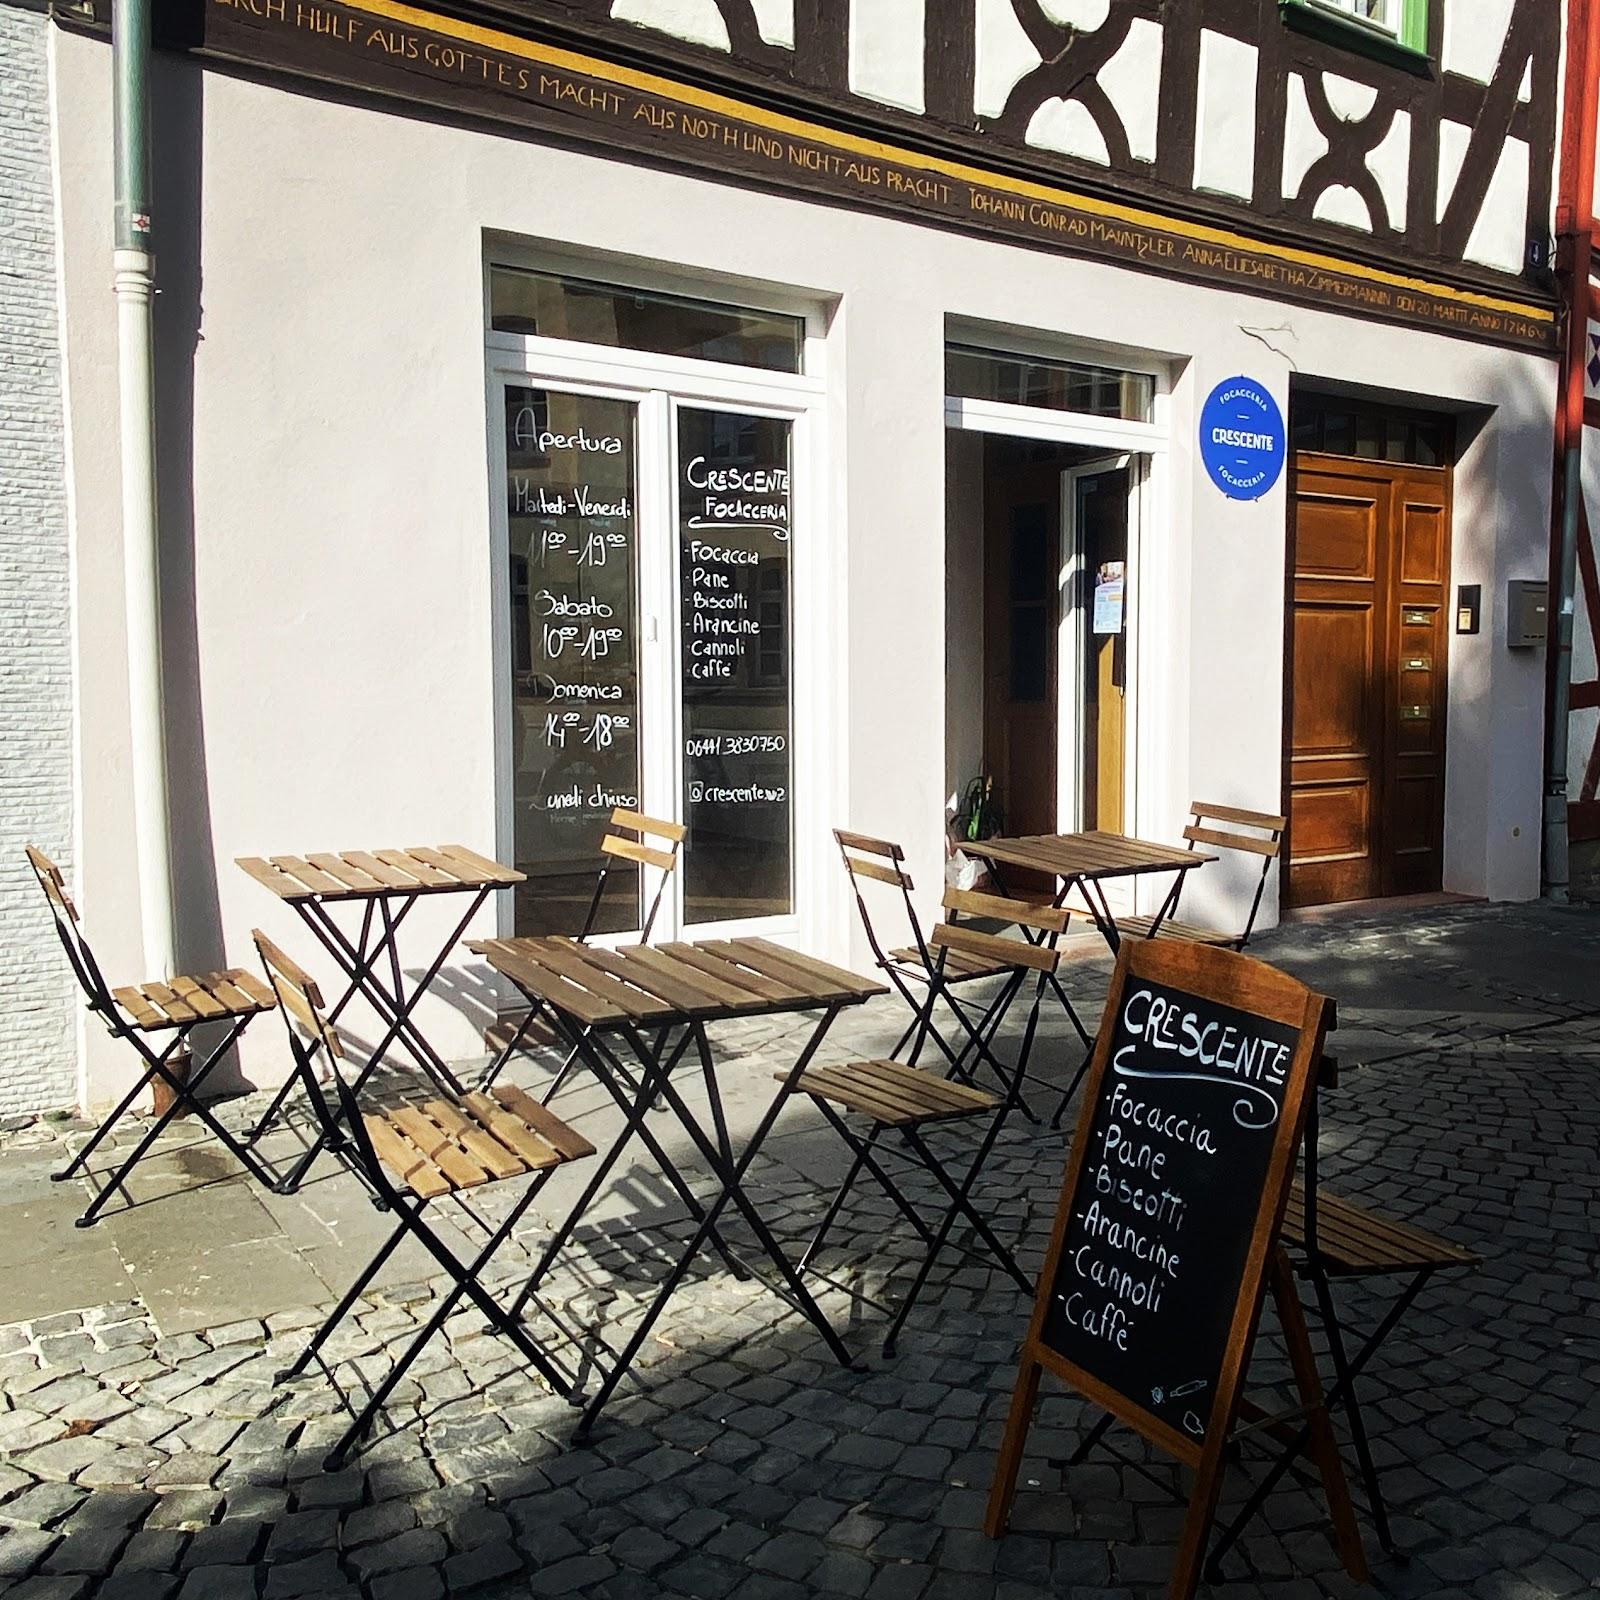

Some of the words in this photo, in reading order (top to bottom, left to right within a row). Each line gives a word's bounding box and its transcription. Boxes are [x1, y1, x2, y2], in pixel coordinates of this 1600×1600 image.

[540, 75, 625, 114] MACHT
[634, 104, 675, 129] AUS
[744, 130, 783, 159] UND
[788, 147, 844, 175] NICHT
[845, 162, 880, 184] AUS
[887, 170, 952, 204] PRACHT
[1219, 389, 1268, 412] FOCACCERIA
[515, 407, 622, 453] Apertura
[1212, 428, 1273, 451] CRESCENTE
[1217, 465, 1266, 488] FOCACCERIA
[535, 590, 614, 617] Sabato
[588, 783, 637, 808] chiuso
[1124, 990, 1290, 1085] CRESCENTE
